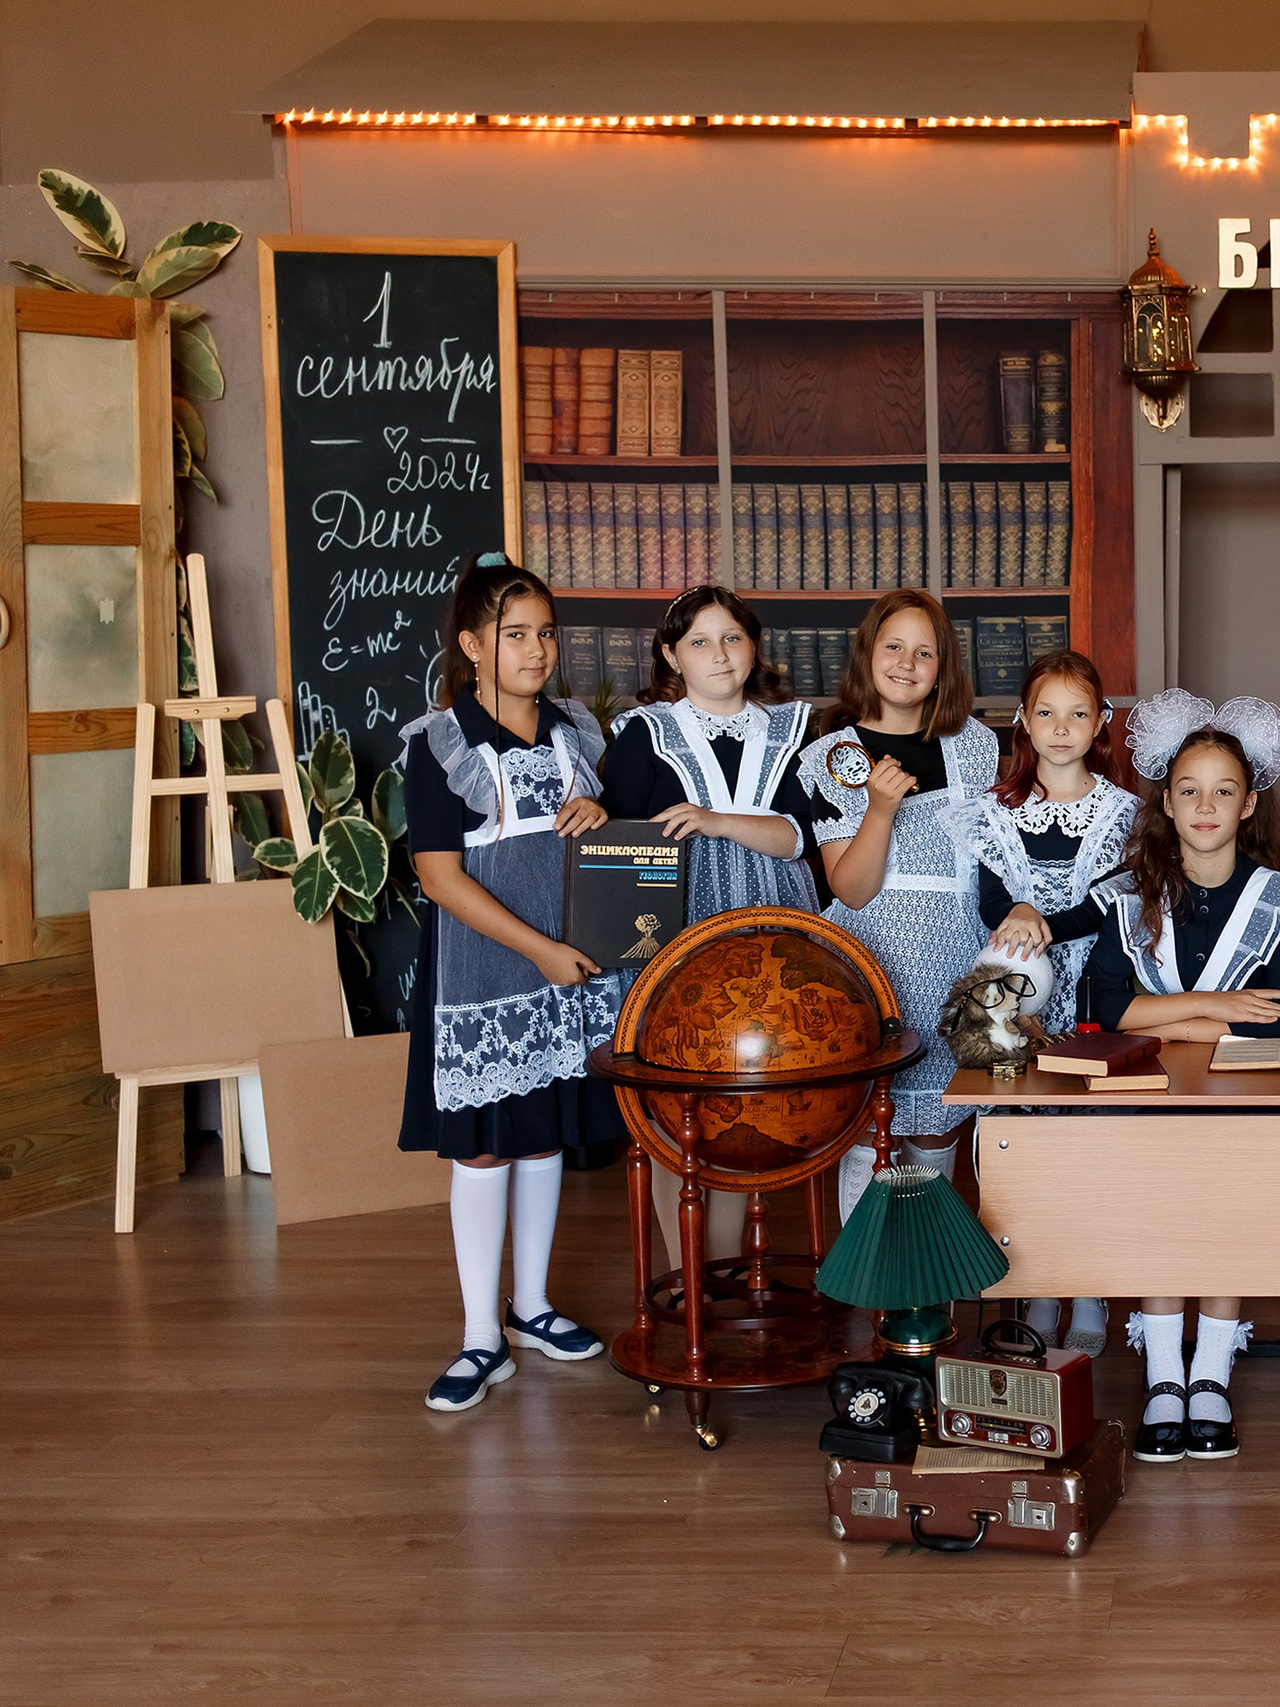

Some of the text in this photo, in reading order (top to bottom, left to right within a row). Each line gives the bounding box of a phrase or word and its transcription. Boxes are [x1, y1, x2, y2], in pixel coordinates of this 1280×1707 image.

[362, 270, 393, 349] 1
[296, 336, 497, 423] сентября
[311, 490, 443, 551] День
[323, 555, 461, 631] знаний
[580, 844, 679, 857] ЭНЦИКЛОПЕДИЯ
